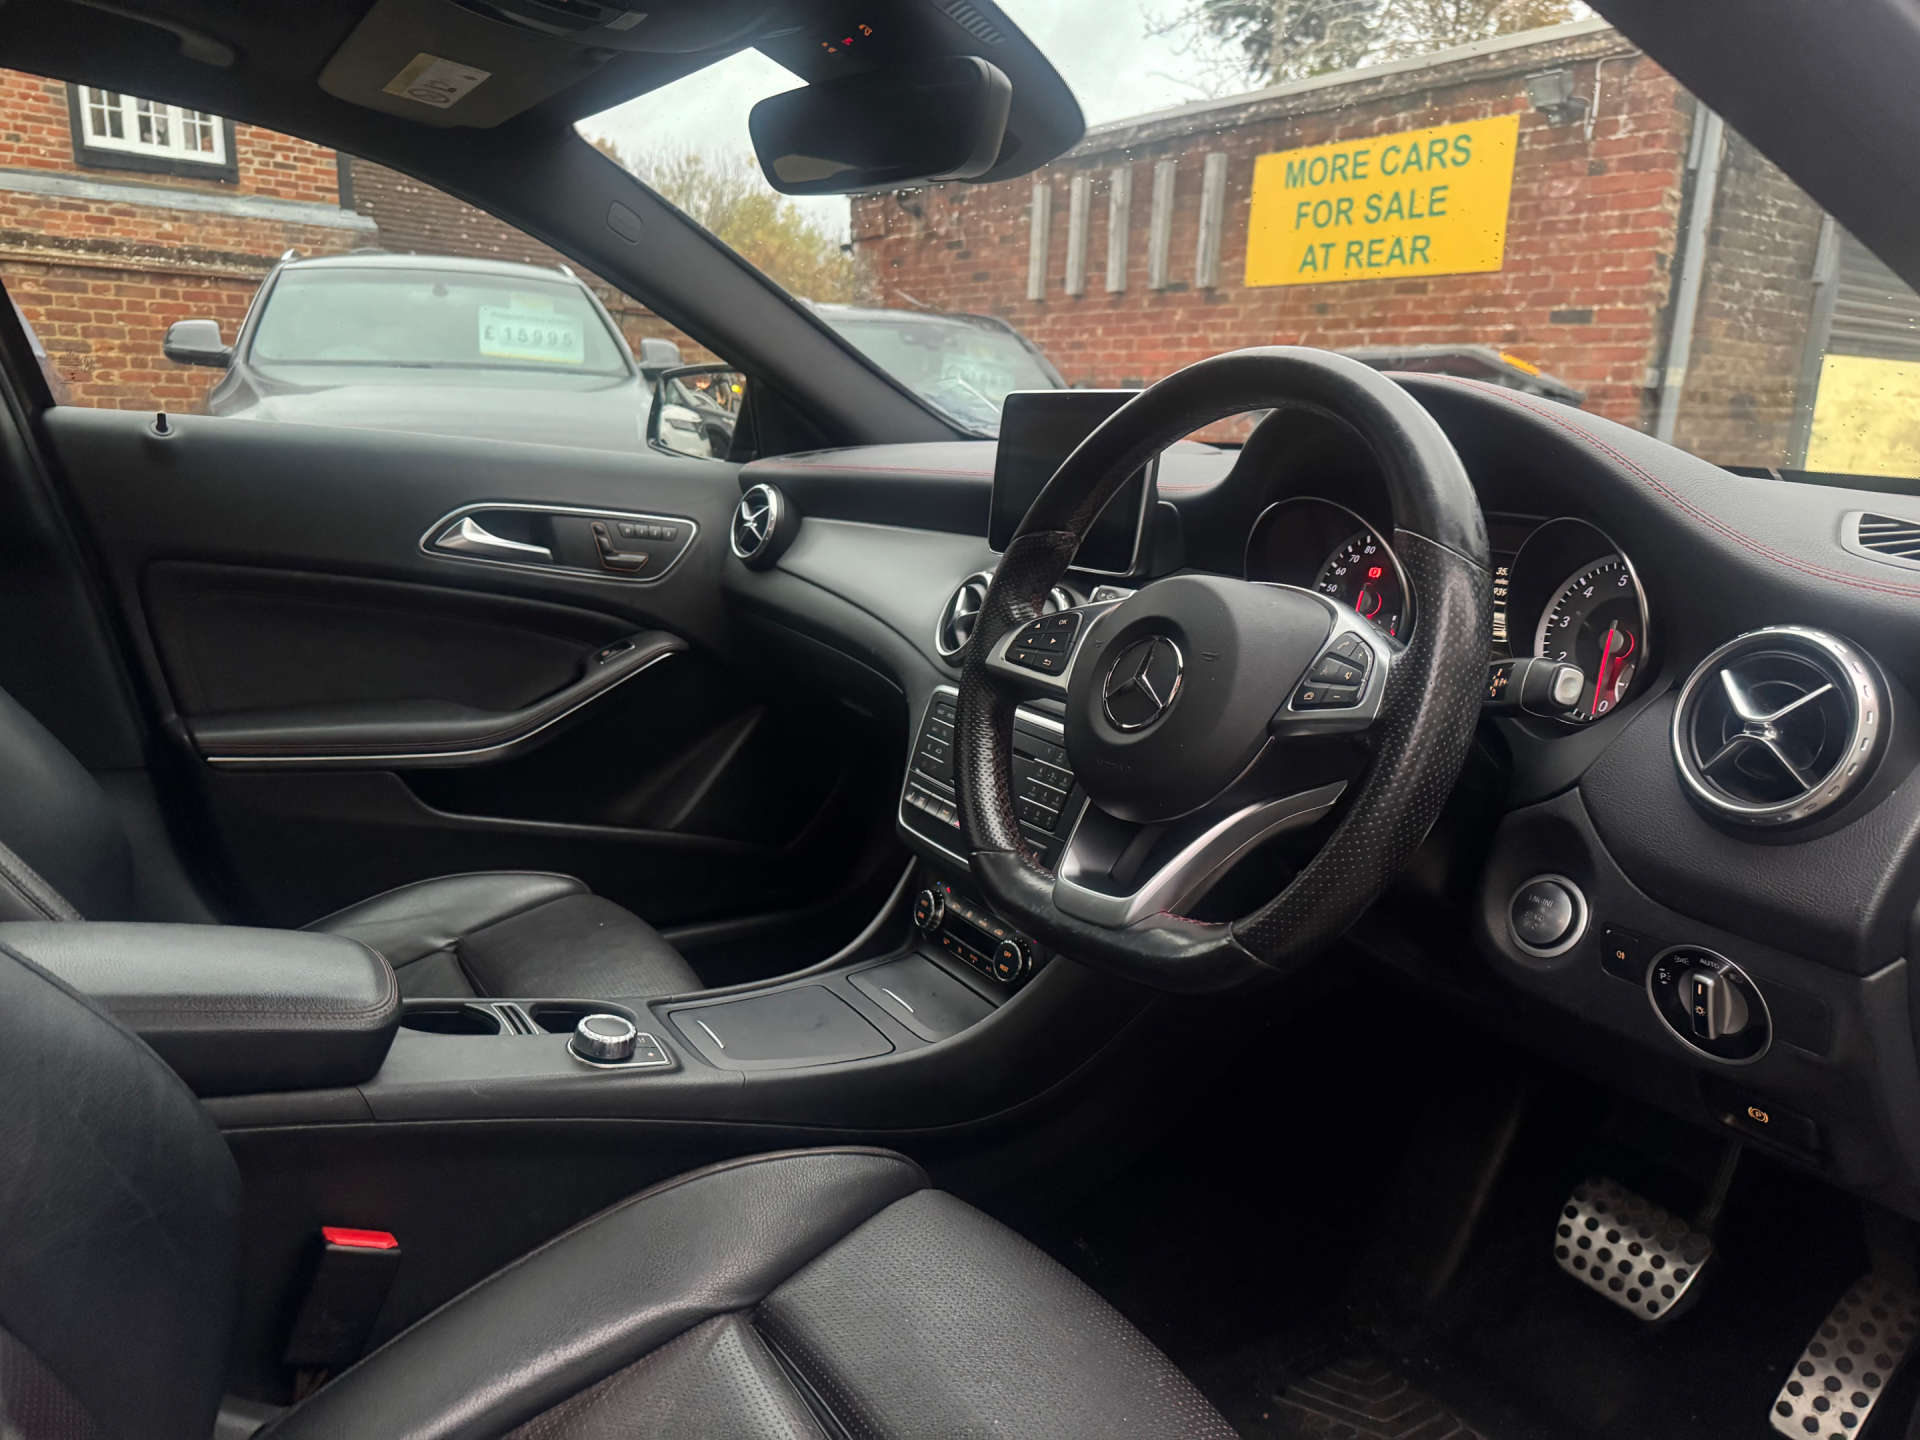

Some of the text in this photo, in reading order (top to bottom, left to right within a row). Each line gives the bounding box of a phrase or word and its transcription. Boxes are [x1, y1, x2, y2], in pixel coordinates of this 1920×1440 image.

[1285, 134, 1472, 189] MORE CARS
[1296, 185, 1448, 230] FOR SALE
[1299, 235, 1431, 273] AT REAR
[1364, 545, 1376, 555] 80
[1350, 553, 1361, 564] 70
[1335, 566, 1347, 576] 60
[1617, 574, 1629, 587] 5
[1326, 583, 1338, 593] 50
[1583, 585, 1595, 599] 4
[1559, 615, 1571, 628] 3
[1598, 700, 1609, 712] 0
